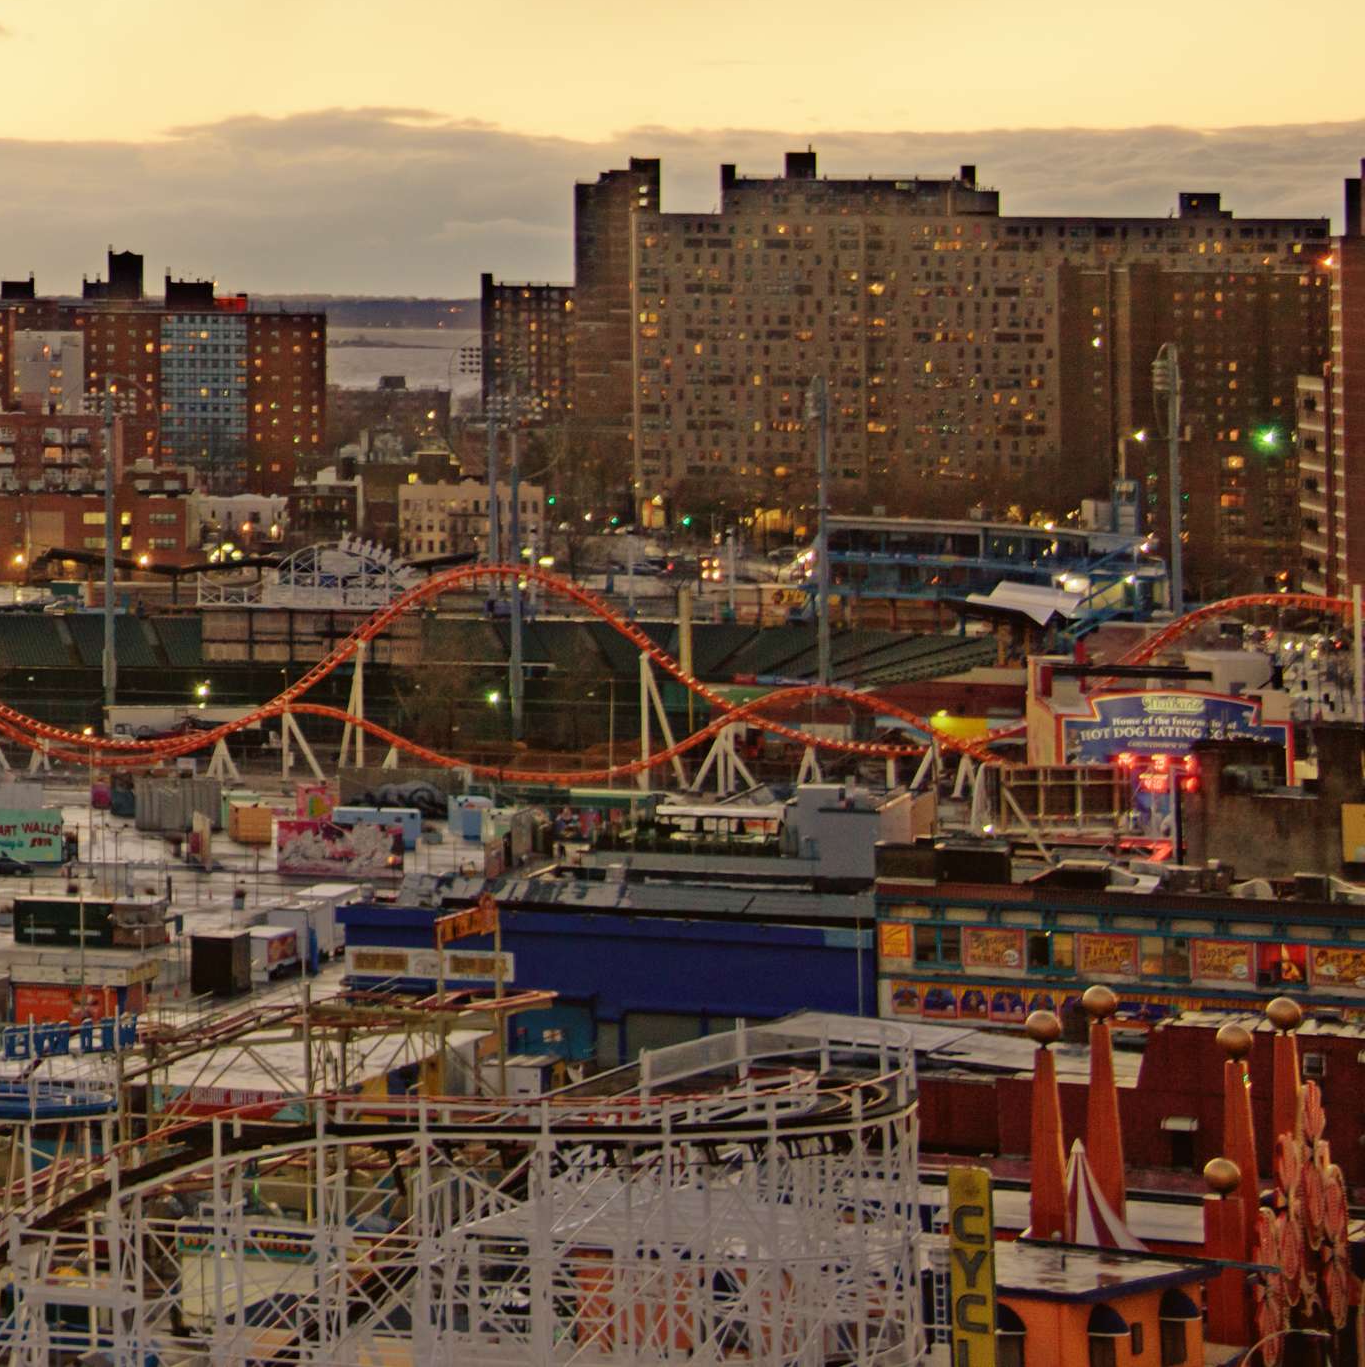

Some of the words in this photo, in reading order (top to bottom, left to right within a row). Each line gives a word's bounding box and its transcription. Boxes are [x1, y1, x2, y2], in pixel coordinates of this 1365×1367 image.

[1112, 716, 1140, 726] Home
[1142, 715, 1153, 726] of
[1154, 714, 1170, 726] the
[1080, 727, 1110, 742] HOT
[1112, 725, 1146, 739] DOG
[1148, 724, 1203, 739] EATING
[21, 822, 61, 836] WALLS
